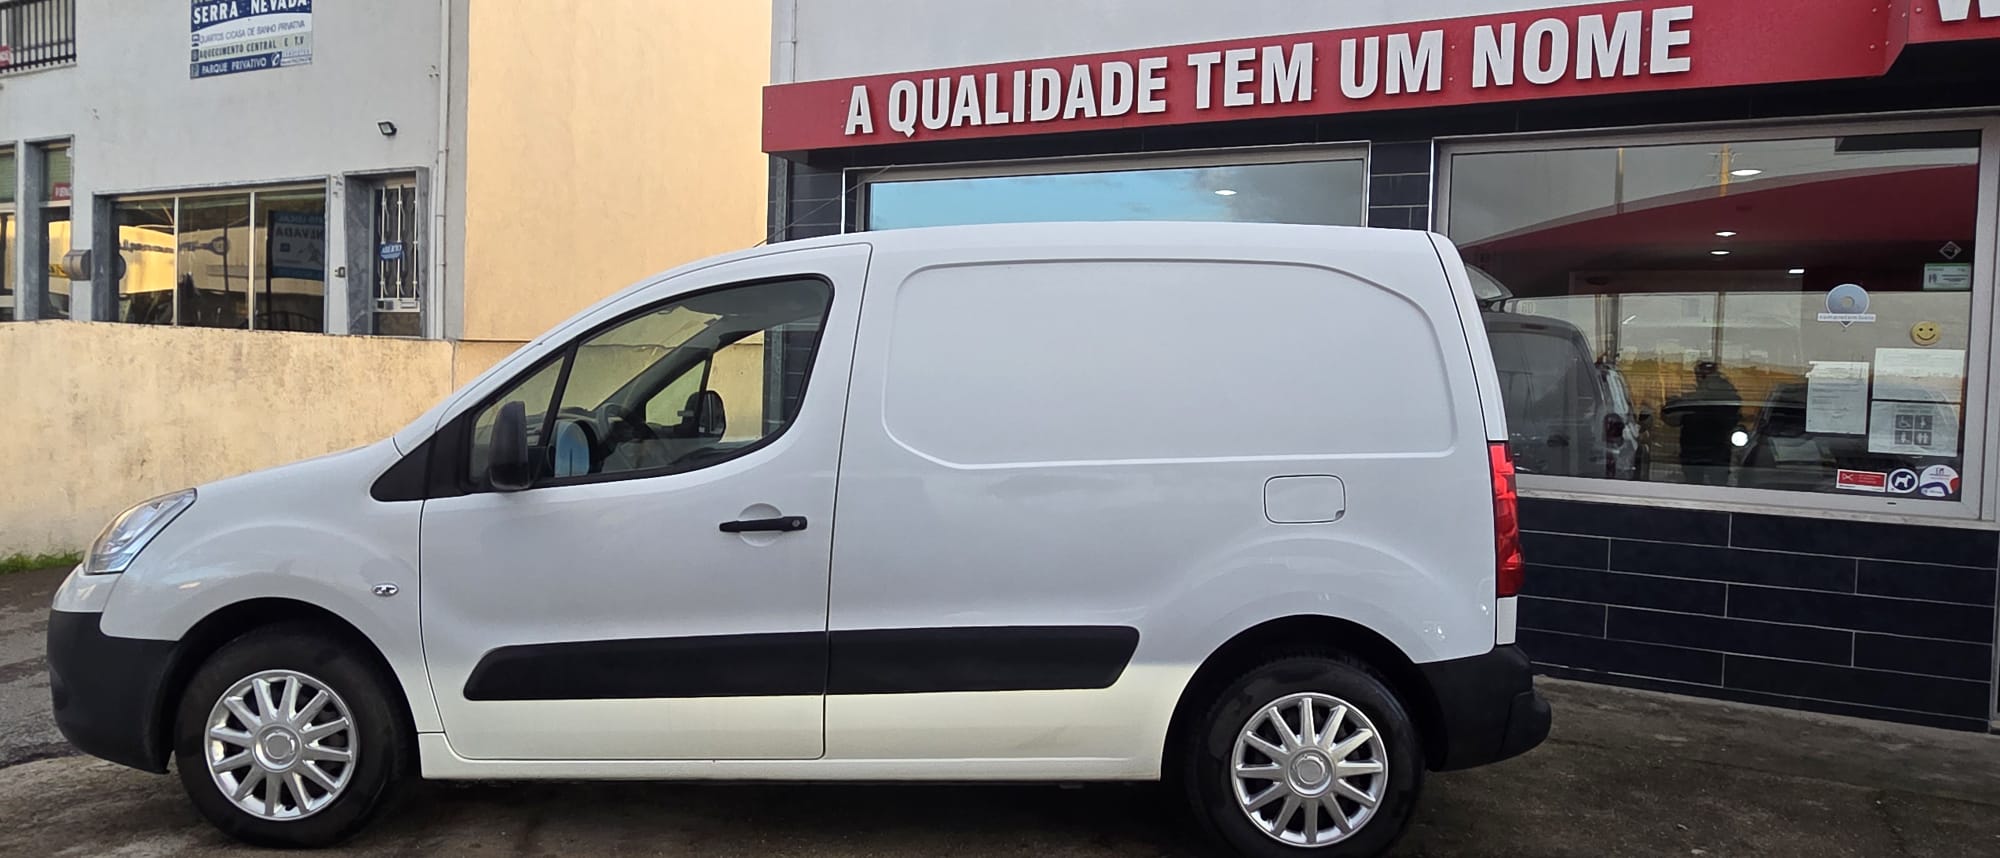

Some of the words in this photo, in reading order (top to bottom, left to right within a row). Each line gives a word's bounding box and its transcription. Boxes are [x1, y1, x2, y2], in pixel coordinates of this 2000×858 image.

[193, 1, 238, 24] SERRA
[247, 27, 255, 36] DE
[256, 24, 277, 35] BANHO
[200, 43, 244, 59] AQUECIMENTO
[246, 39, 277, 53] CENTRAL
[284, 37, 288, 47] E
[201, 61, 228, 75] PARQUE
[231, 56, 267, 72] PRIVATIVO
[845, 85, 873, 135] A
[888, 57, 1167, 138] QUALIDADE
[1187, 42, 1313, 109] TEM
[1340, 29, 1443, 98] UM
[1472, 5, 1693, 88] NOME
